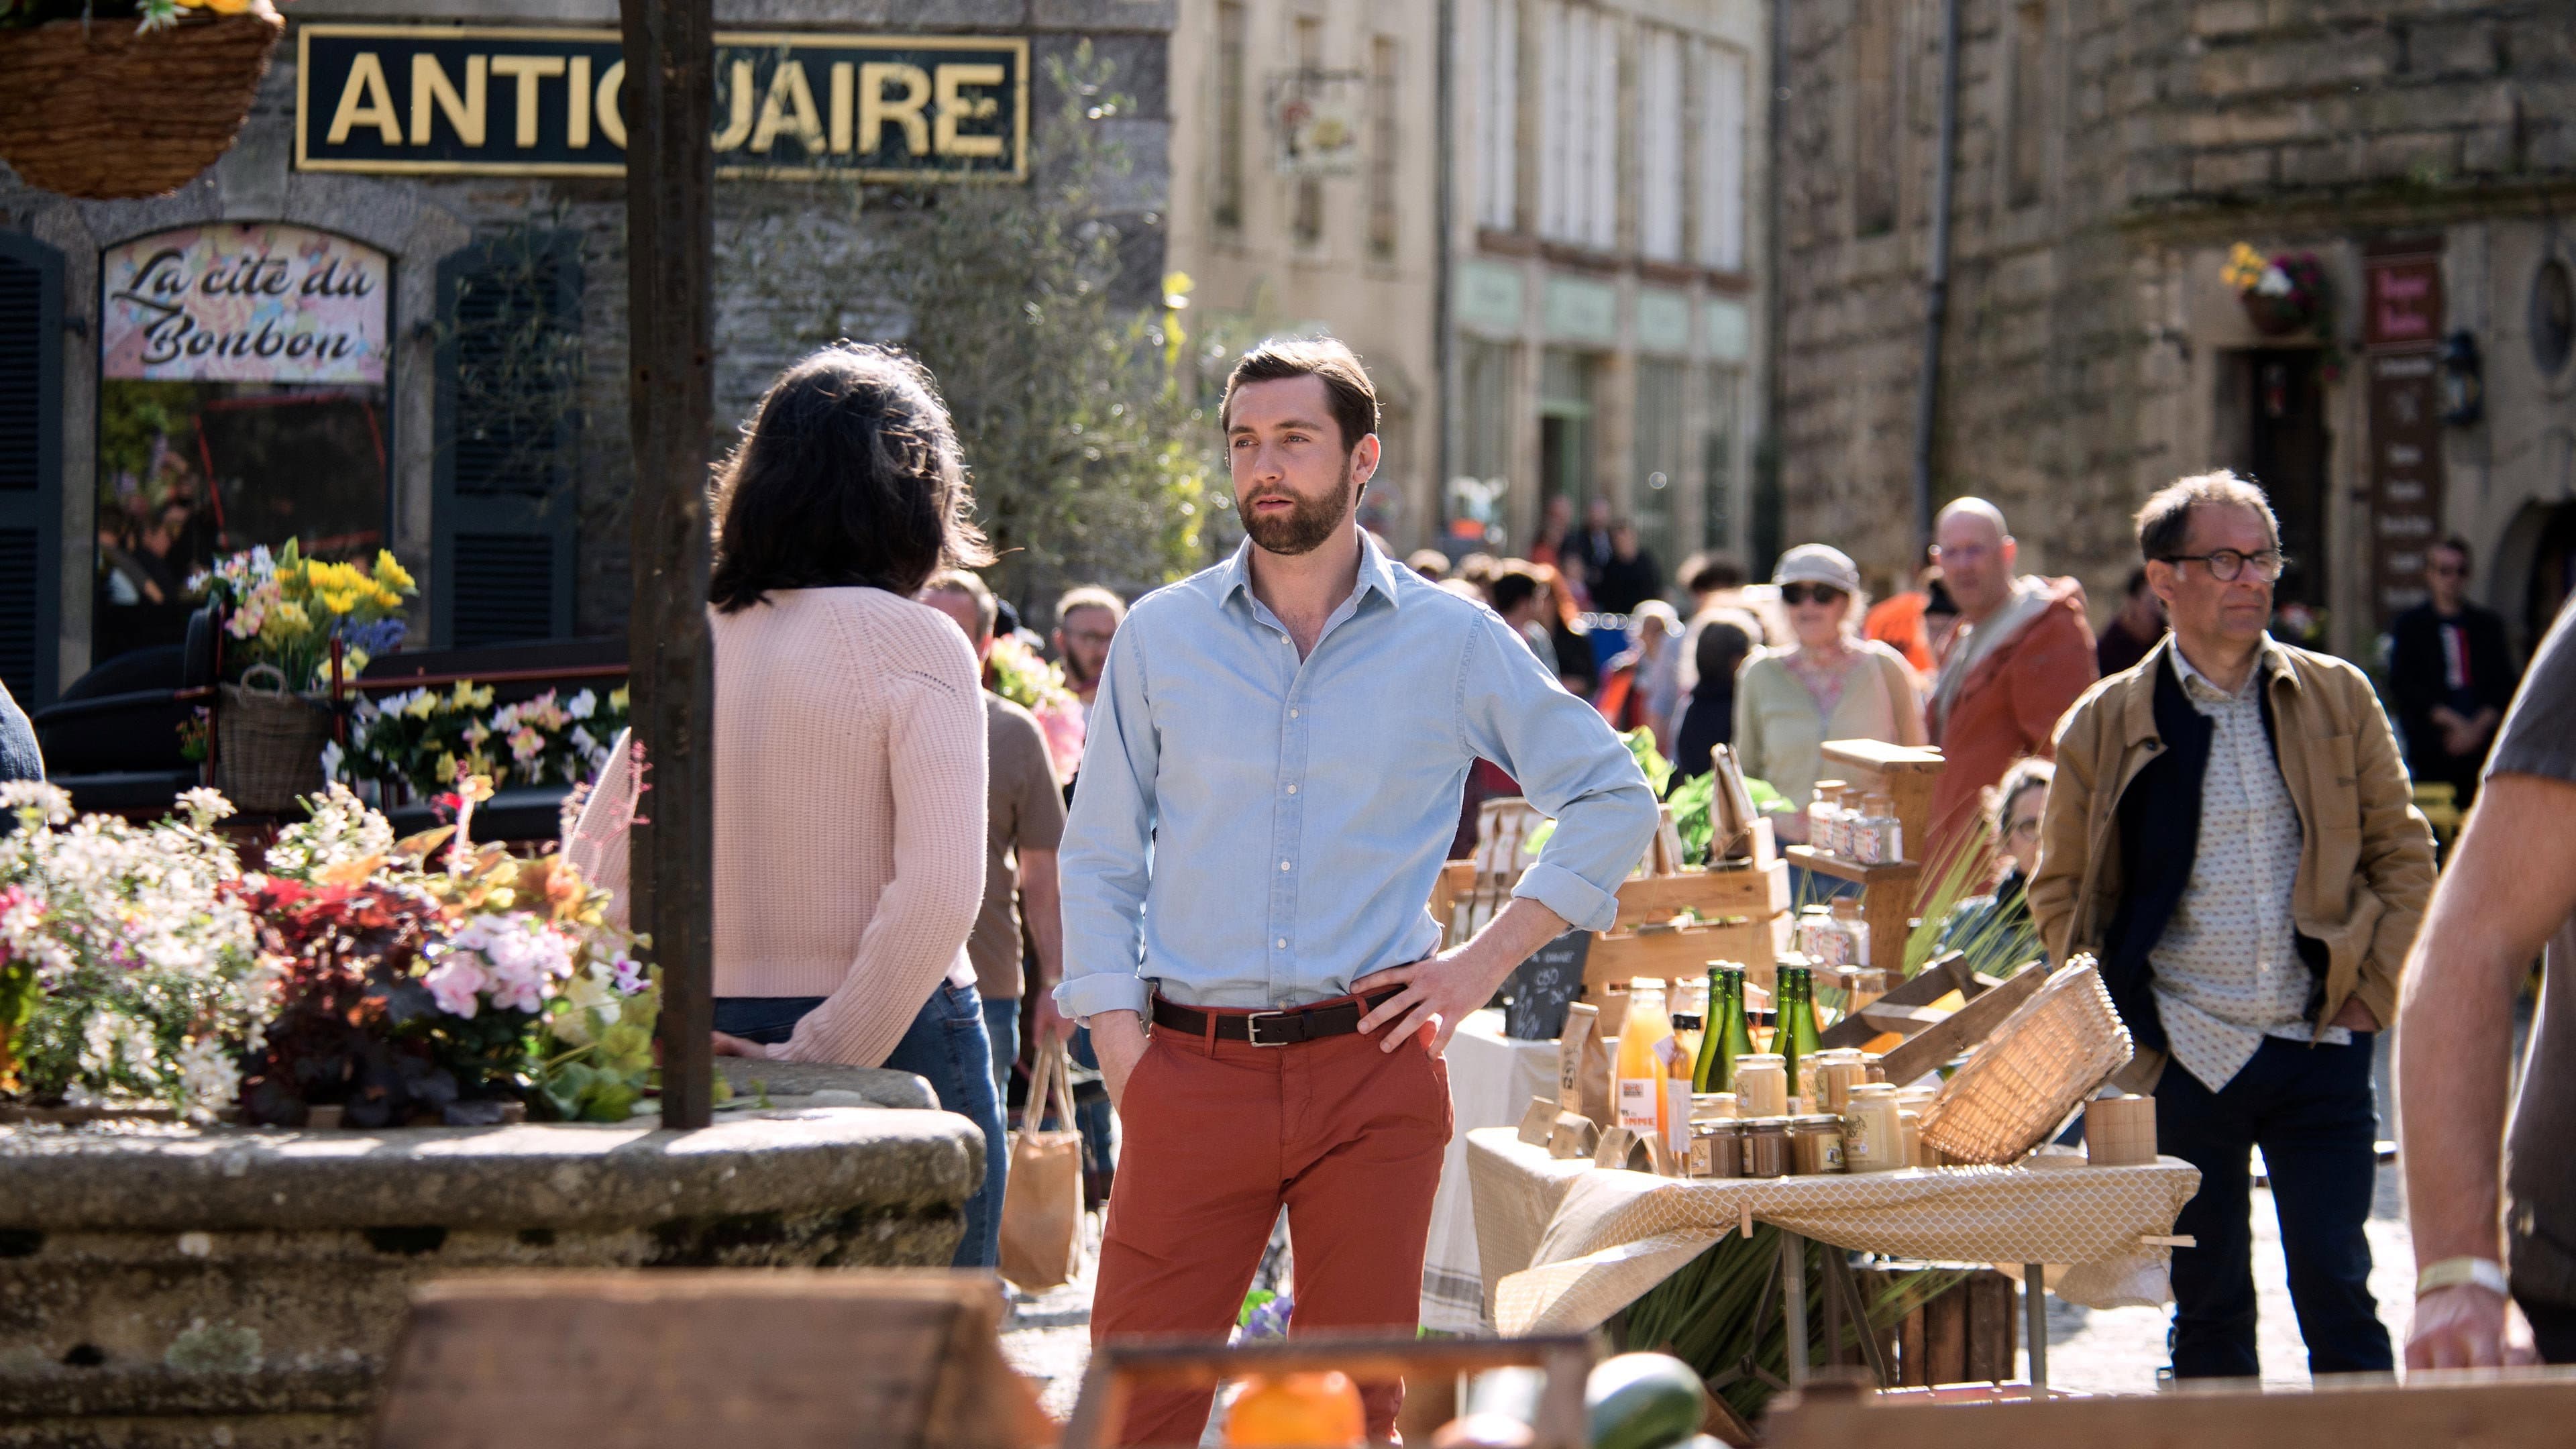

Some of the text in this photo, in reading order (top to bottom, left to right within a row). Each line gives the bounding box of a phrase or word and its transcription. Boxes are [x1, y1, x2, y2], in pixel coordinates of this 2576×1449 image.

[111, 248, 193, 313] La
[301, 257, 376, 298] du
[141, 311, 356, 365] Bonbon
